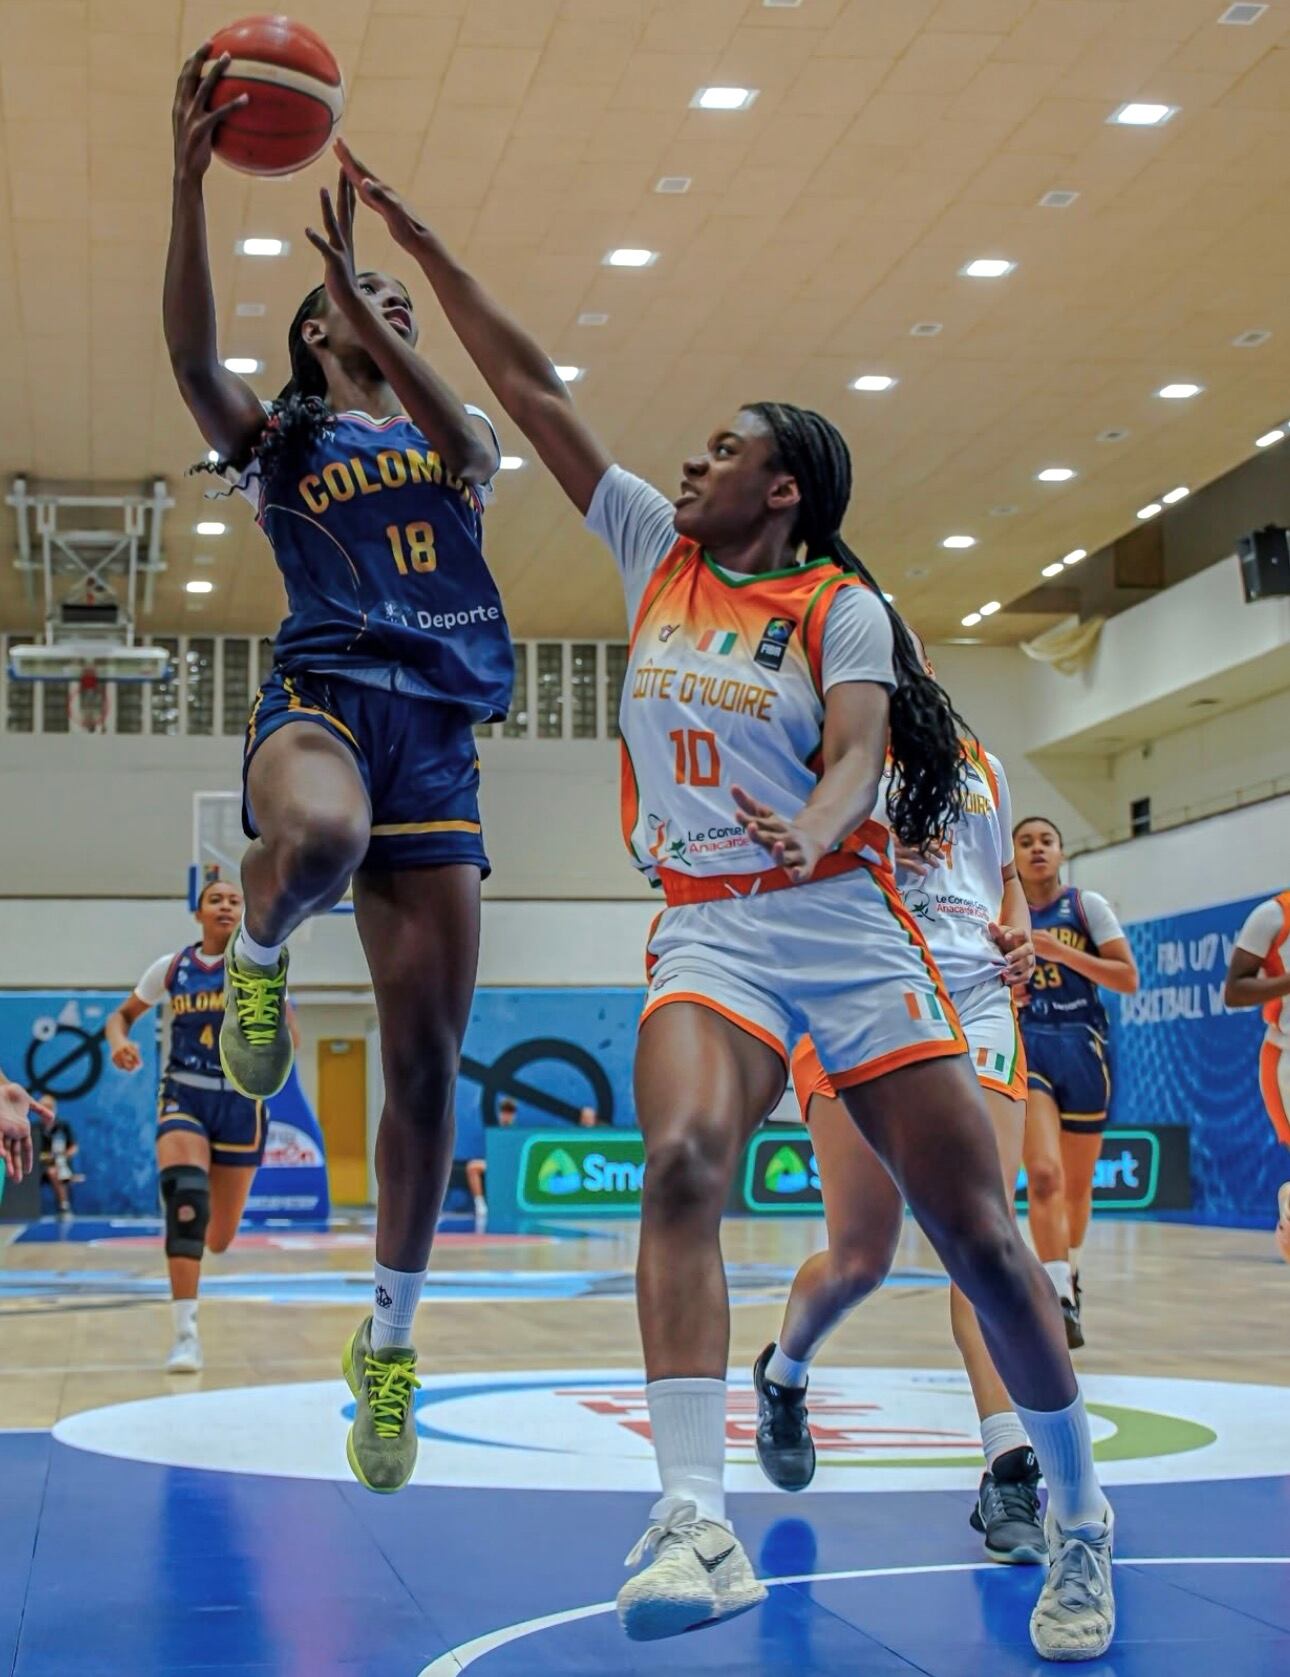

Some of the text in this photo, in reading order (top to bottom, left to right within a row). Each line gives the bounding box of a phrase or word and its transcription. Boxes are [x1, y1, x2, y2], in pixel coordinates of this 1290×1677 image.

[299, 449, 475, 514] COLOM
[386, 521, 437, 575] 18
[417, 606, 499, 629] Deporte
[679, 672, 778, 722] D'IVOIRE
[669, 729, 720, 787] 10
[688, 831, 705, 842] Le
[936, 894, 947, 903] Le
[1033, 963, 1062, 990] 33
[172, 992, 225, 1015] OLOM
[200, 1023, 215, 1050] 4
